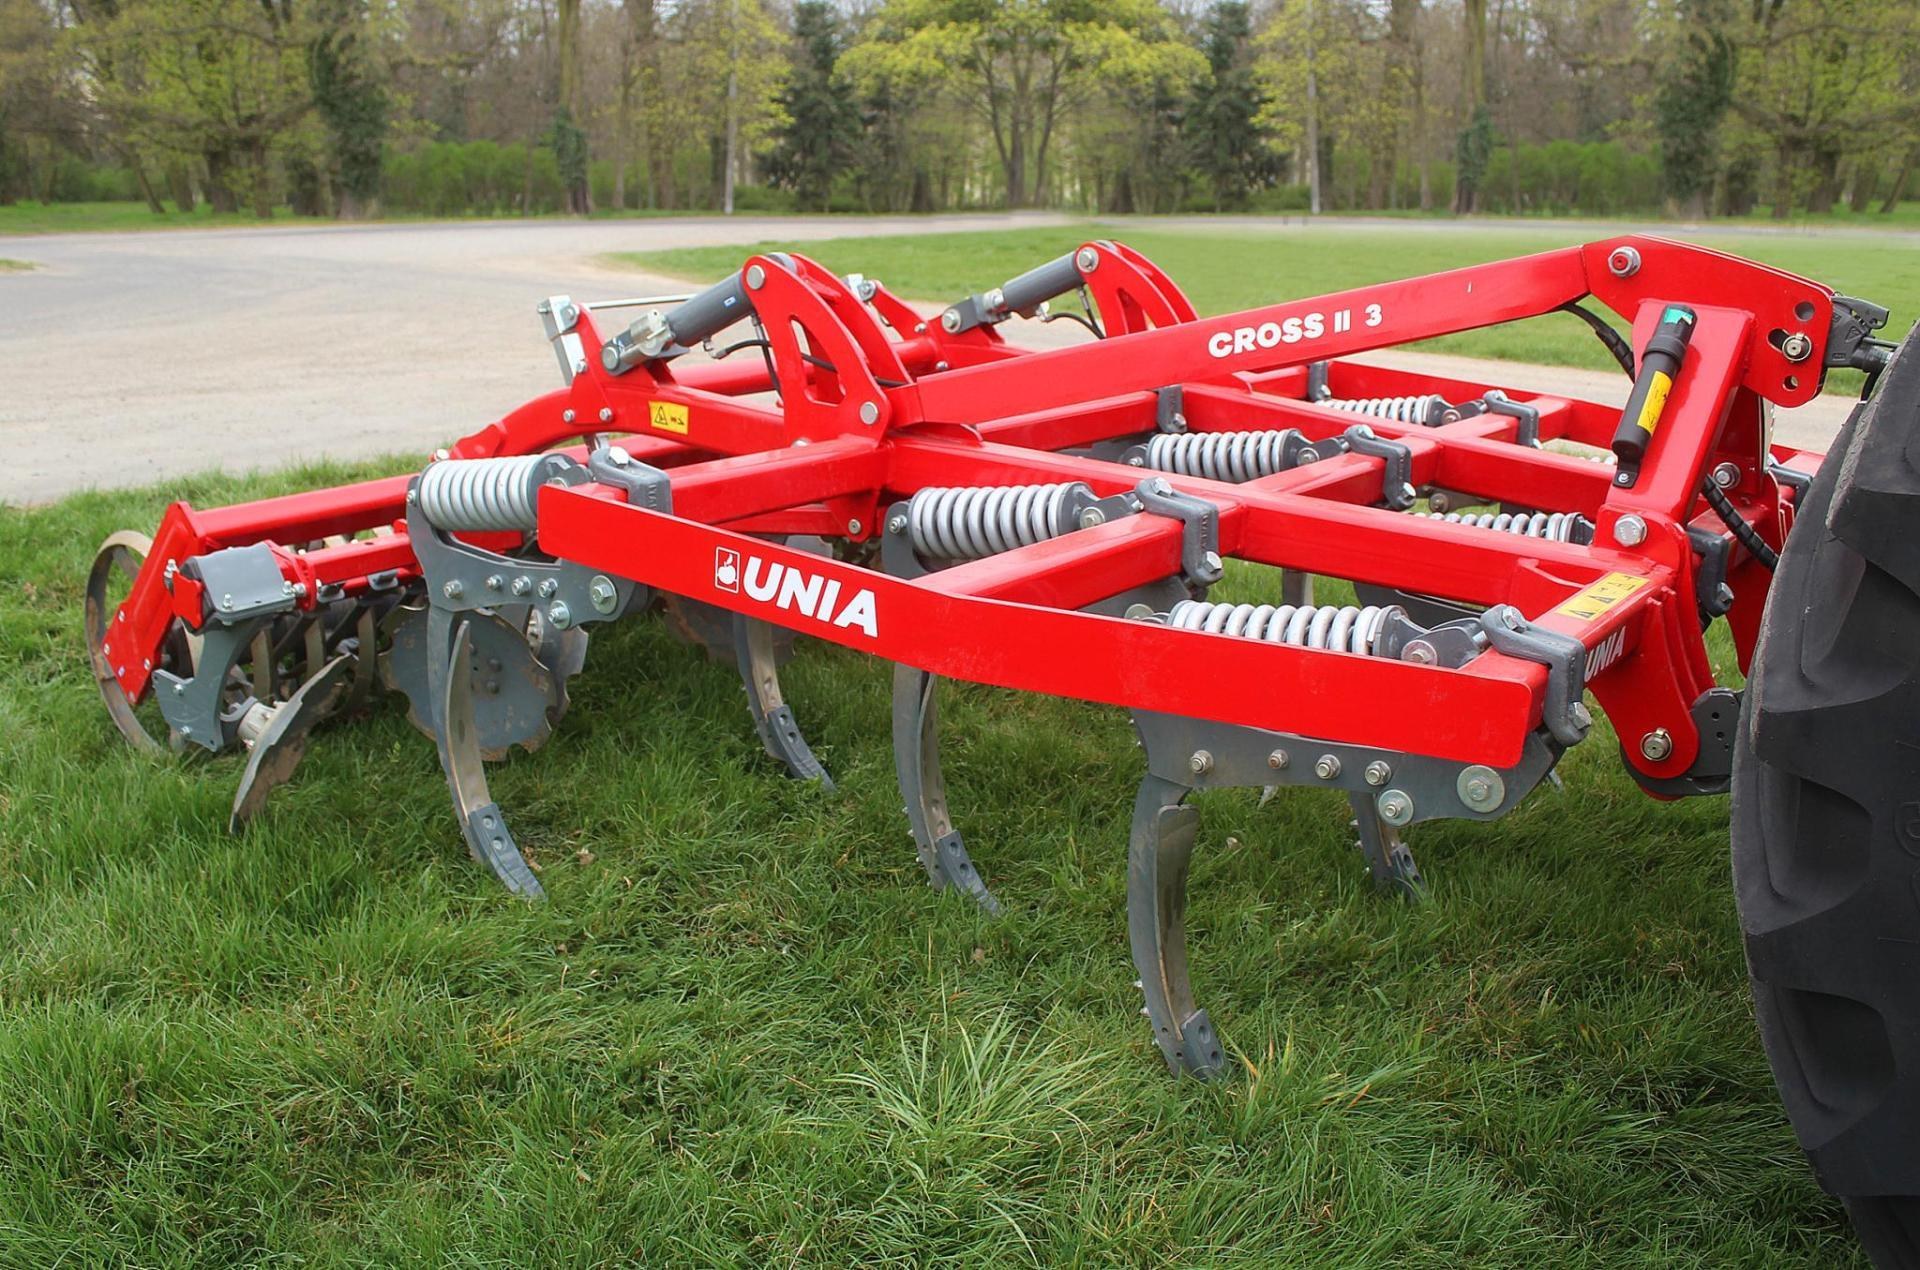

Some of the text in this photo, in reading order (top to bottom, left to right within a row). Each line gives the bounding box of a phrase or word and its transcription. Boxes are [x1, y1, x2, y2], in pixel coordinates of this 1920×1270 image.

[1208, 304, 1382, 357] CROSS II 3
[743, 556, 878, 637] UNIA
[1584, 626, 1626, 682] UNIA
